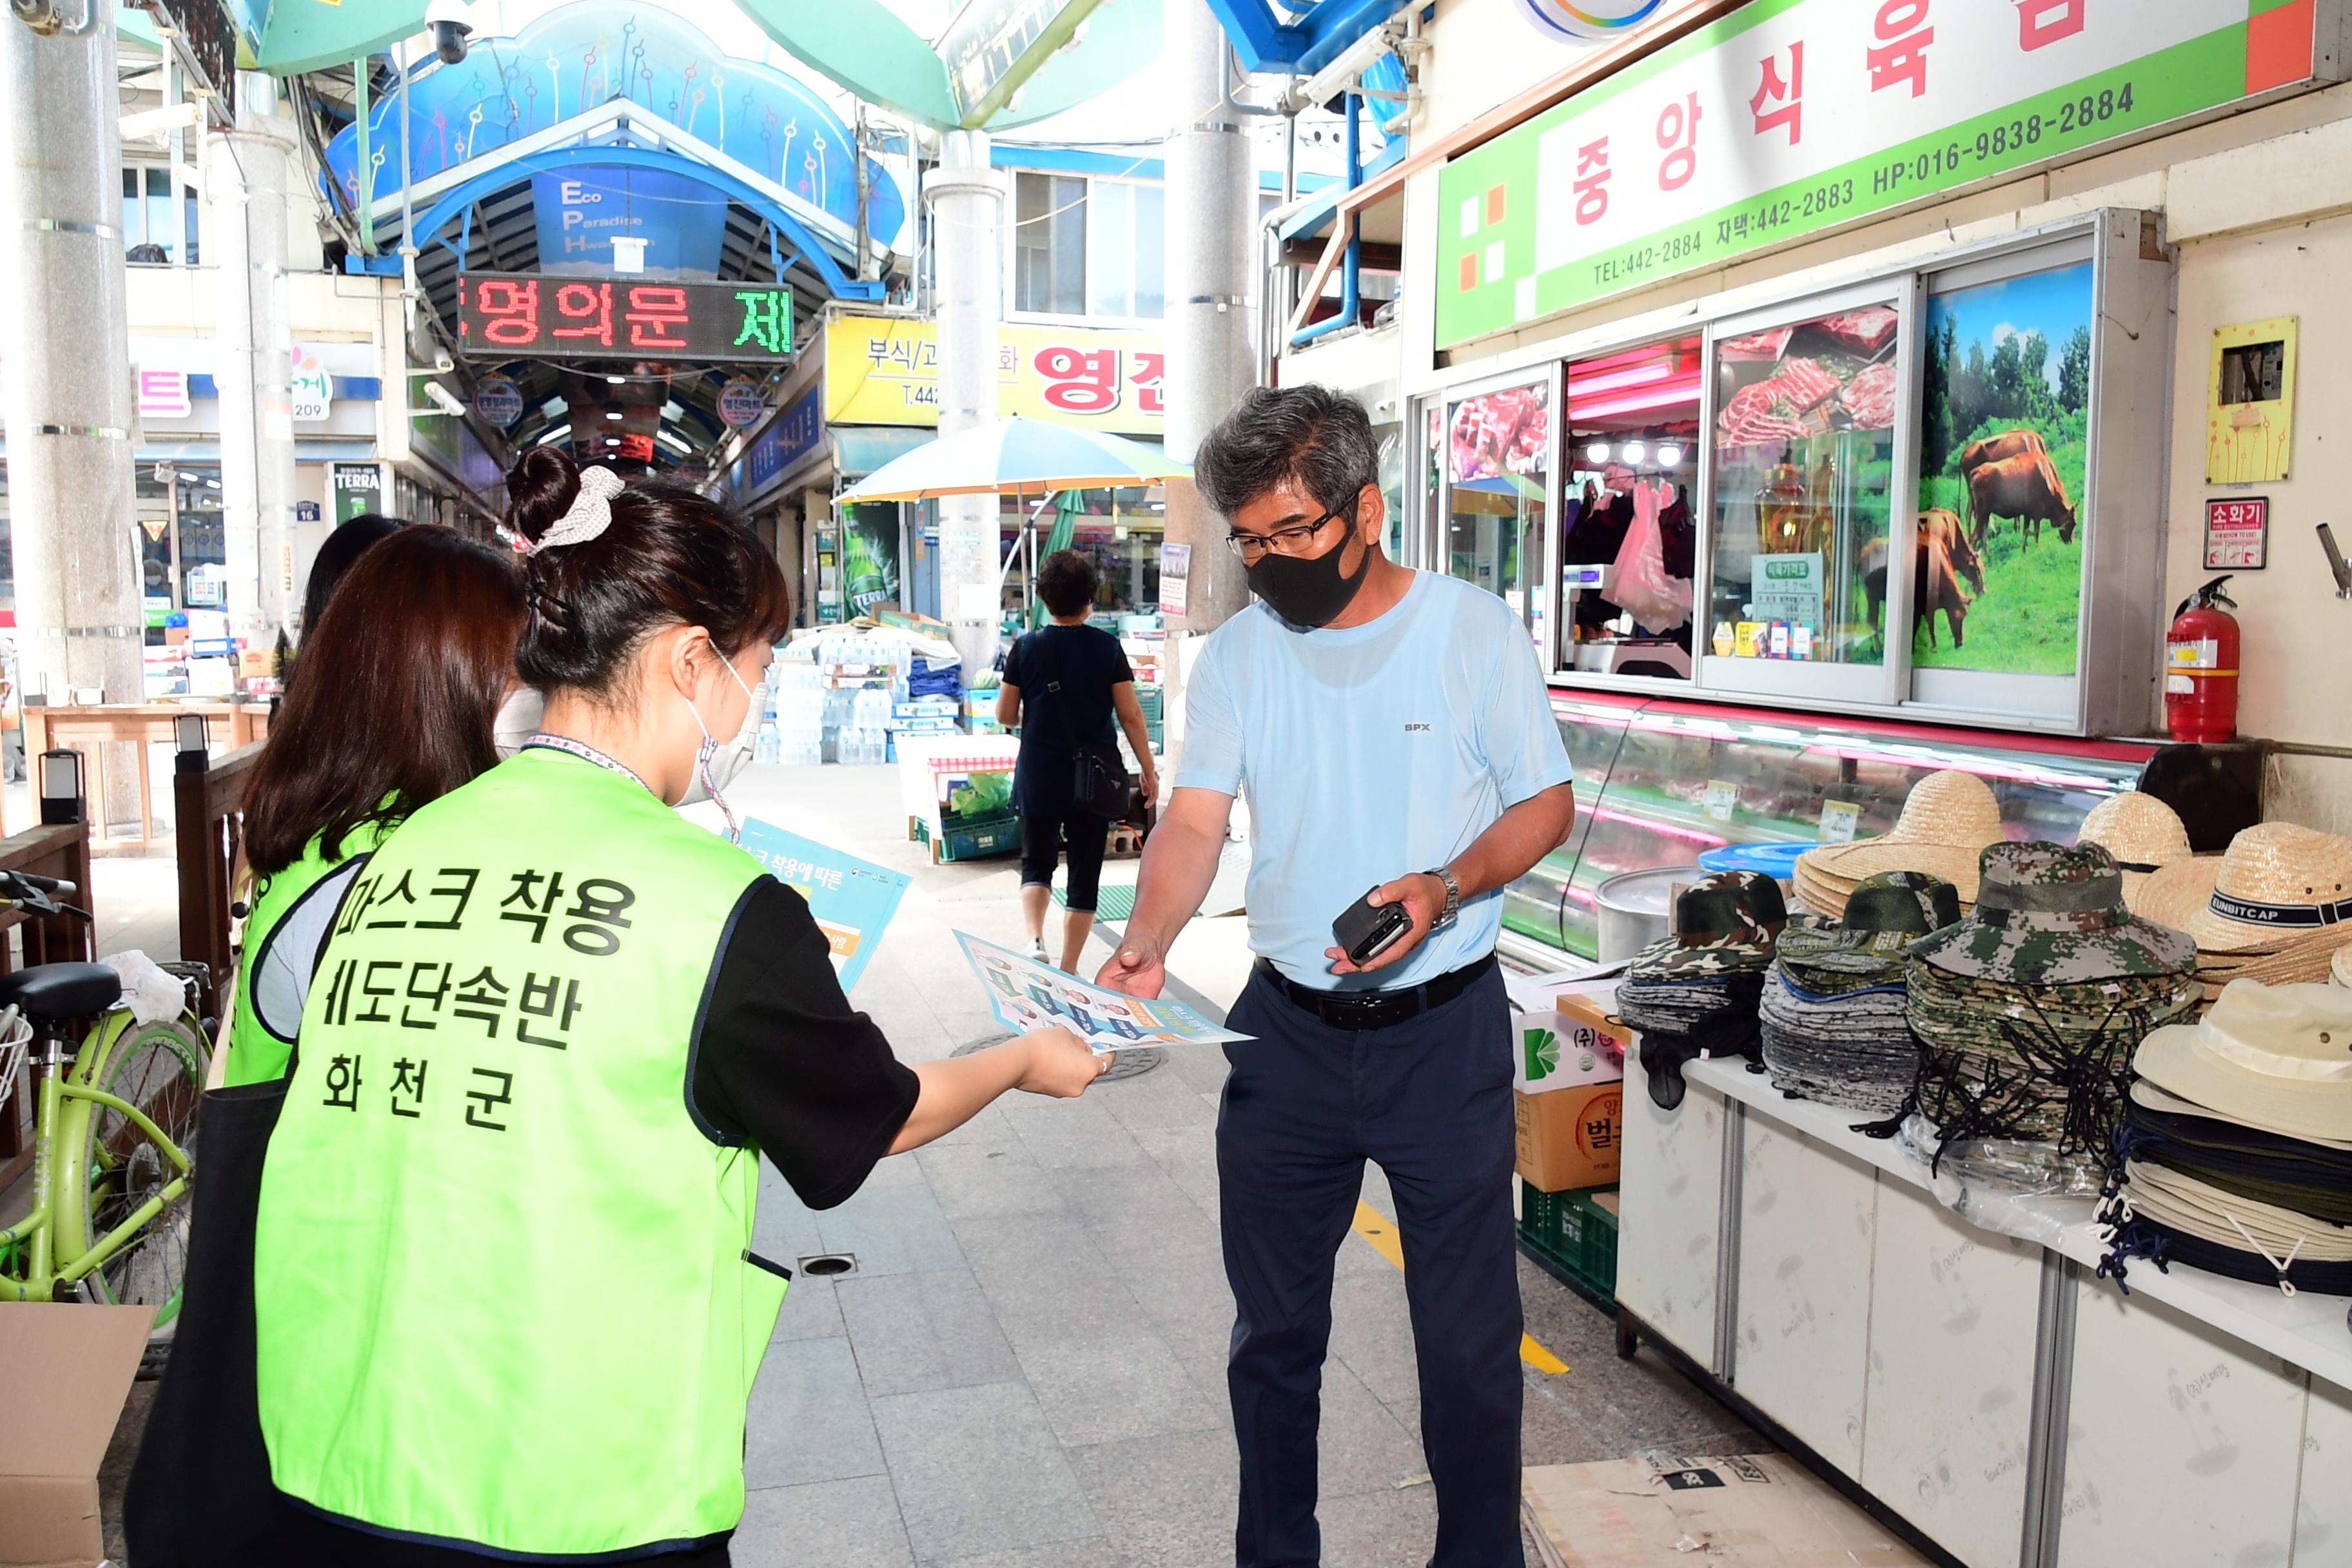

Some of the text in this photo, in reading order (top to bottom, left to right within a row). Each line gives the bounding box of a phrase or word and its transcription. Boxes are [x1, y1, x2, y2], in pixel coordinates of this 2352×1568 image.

[560, 180, 602, 206] Eco
[1593, 82, 2134, 285] TEL:442-2884 자택:442-2883 HP:016-9838-2884
[562, 210, 643, 231] Paradise
[460, 277, 690, 347] 명의문
[335, 473, 380, 490] TERRA
[2212, 504, 2260, 524] 소화기
[1404, 723, 1431, 732] SPX
[770, 853, 814, 882] 착용에
[814, 865, 844, 892] 따른
[335, 867, 636, 956] 마스크 착용
[2212, 897, 2279, 921] EUNBITCAP
[1573, 1027, 1596, 1048] (주)
[1585, 1117, 1622, 1150] 벌
